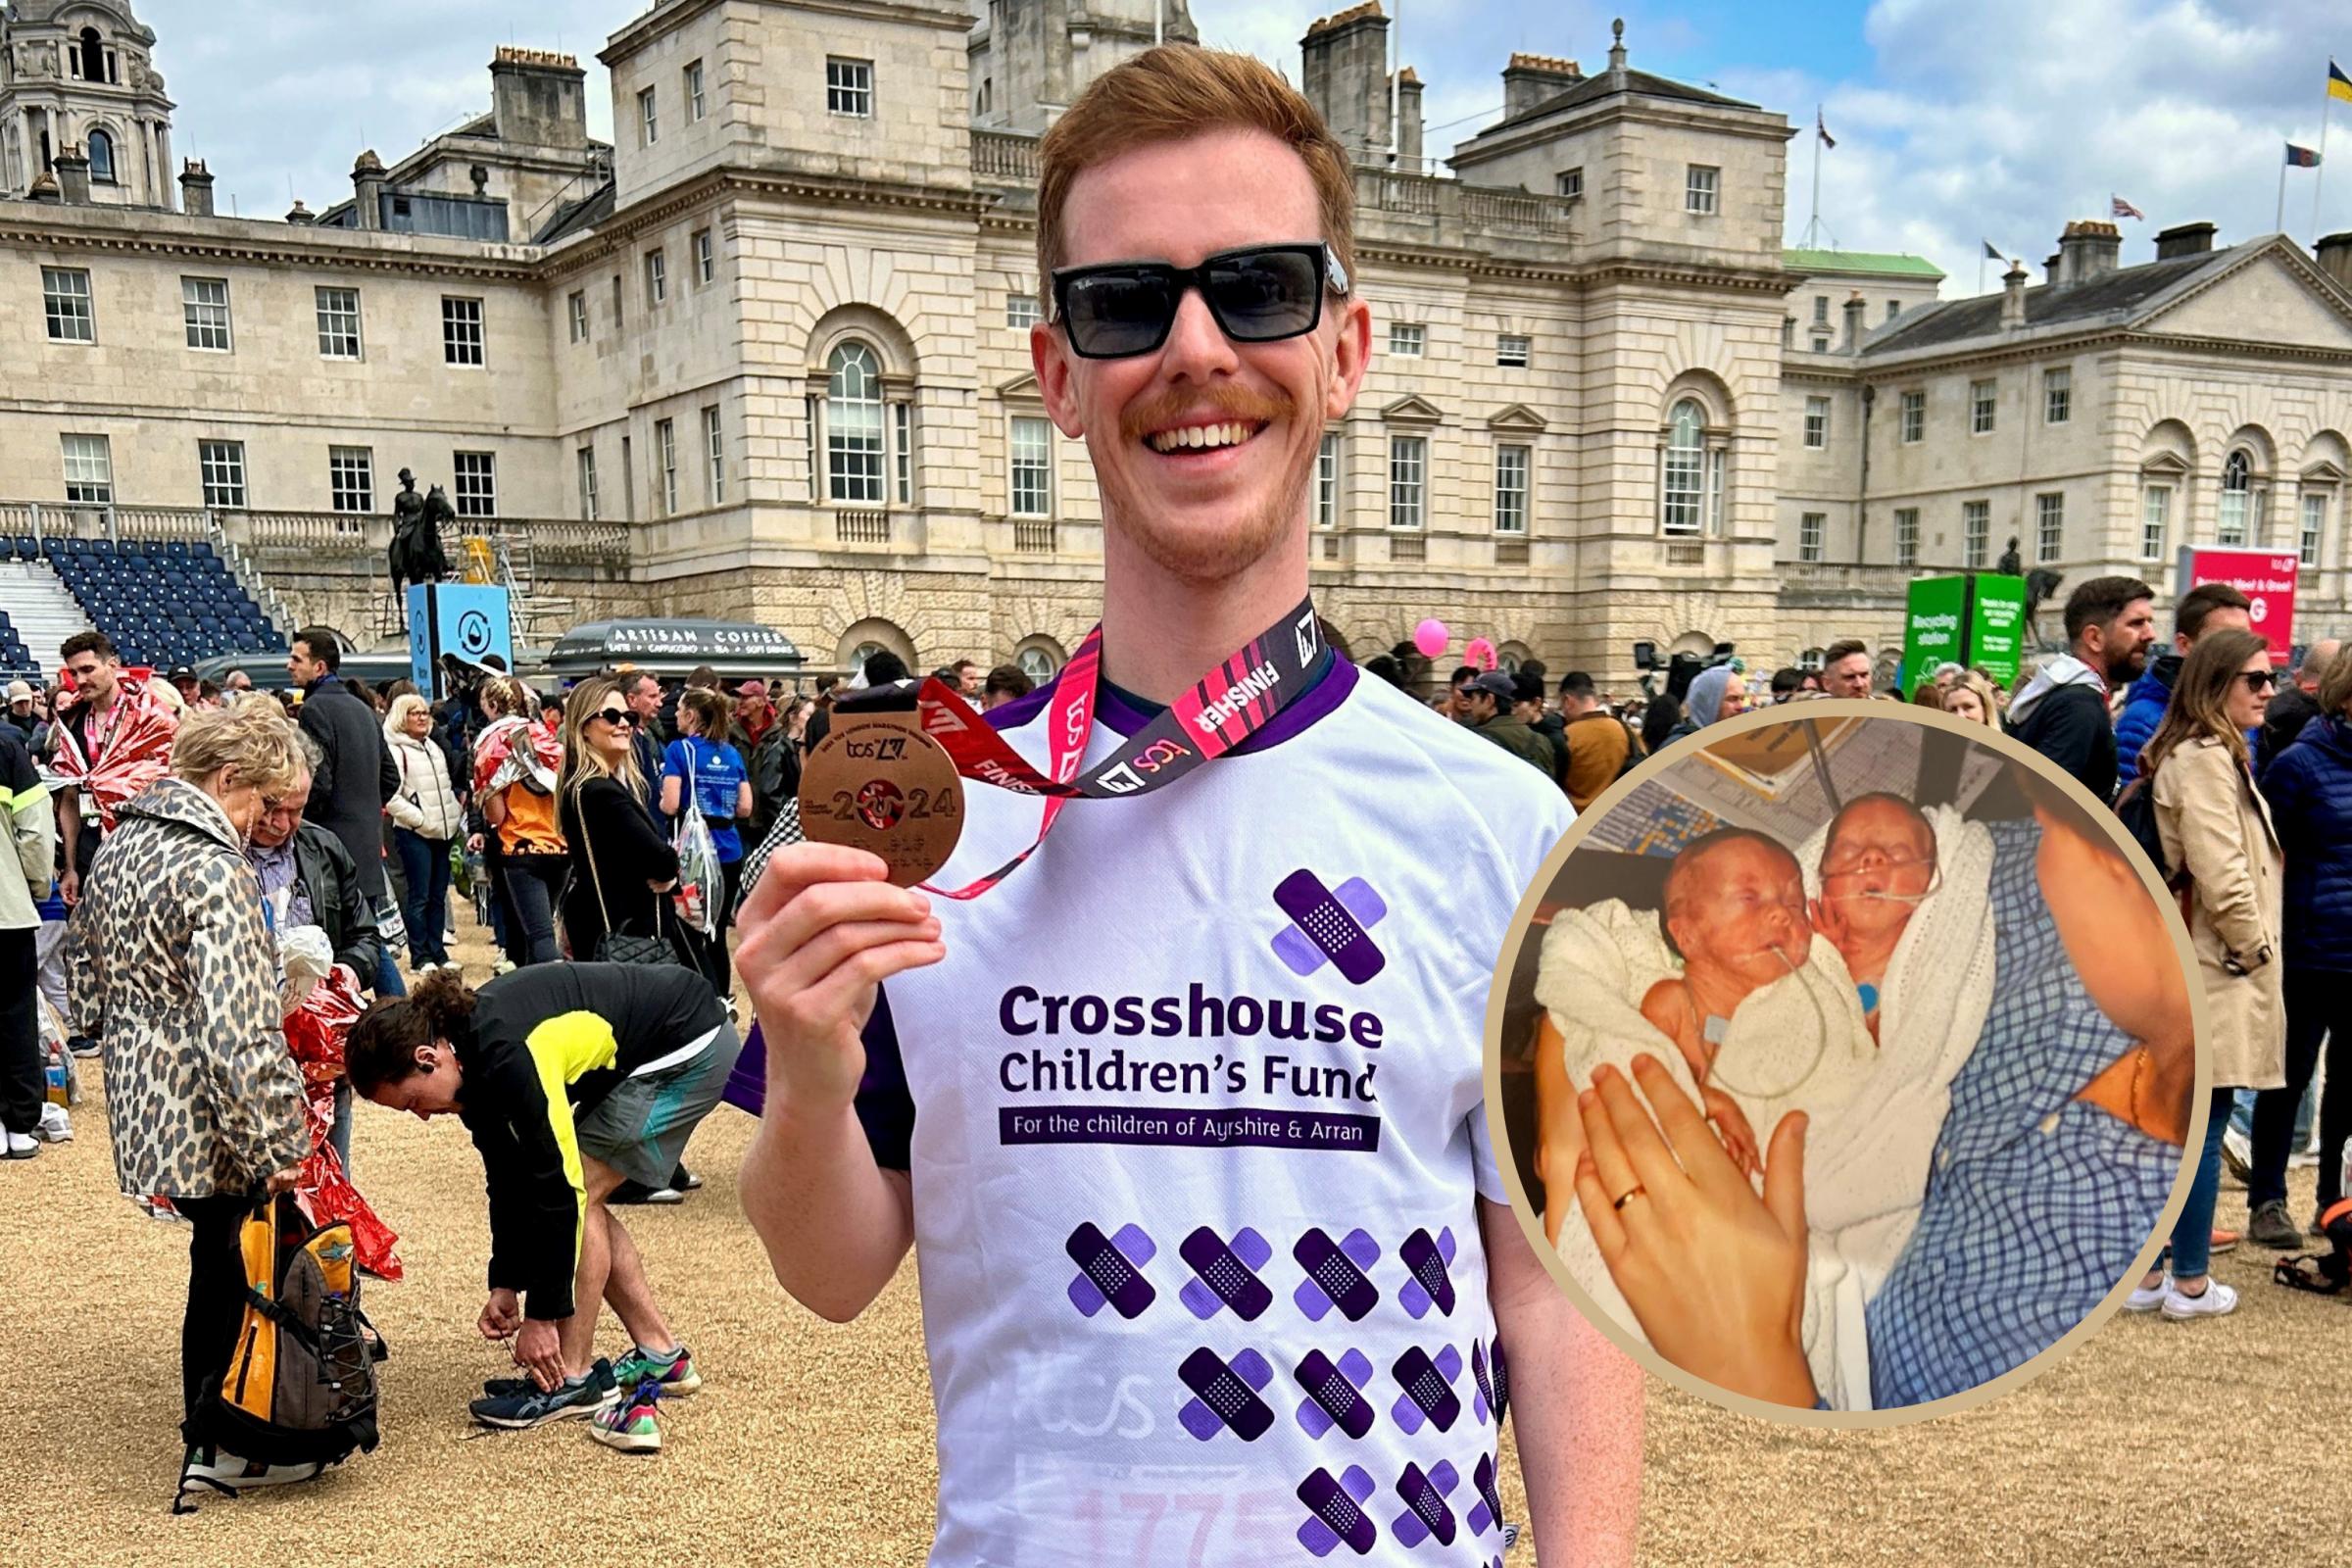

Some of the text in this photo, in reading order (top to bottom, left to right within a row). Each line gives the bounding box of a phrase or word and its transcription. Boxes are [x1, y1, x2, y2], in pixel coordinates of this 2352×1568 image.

[1912, 612, 1958, 631] Recycling
[2249, 596, 2269, 623] G
[714, 630, 783, 644] COFFEE
[1192, 660, 1281, 733] FINISHER
[999, 982, 1385, 1049] Crosshouse
[1263, 1054, 1379, 1103] Fund
[1013, 1113, 1363, 1143] For the children of Ayrshire & Arran
